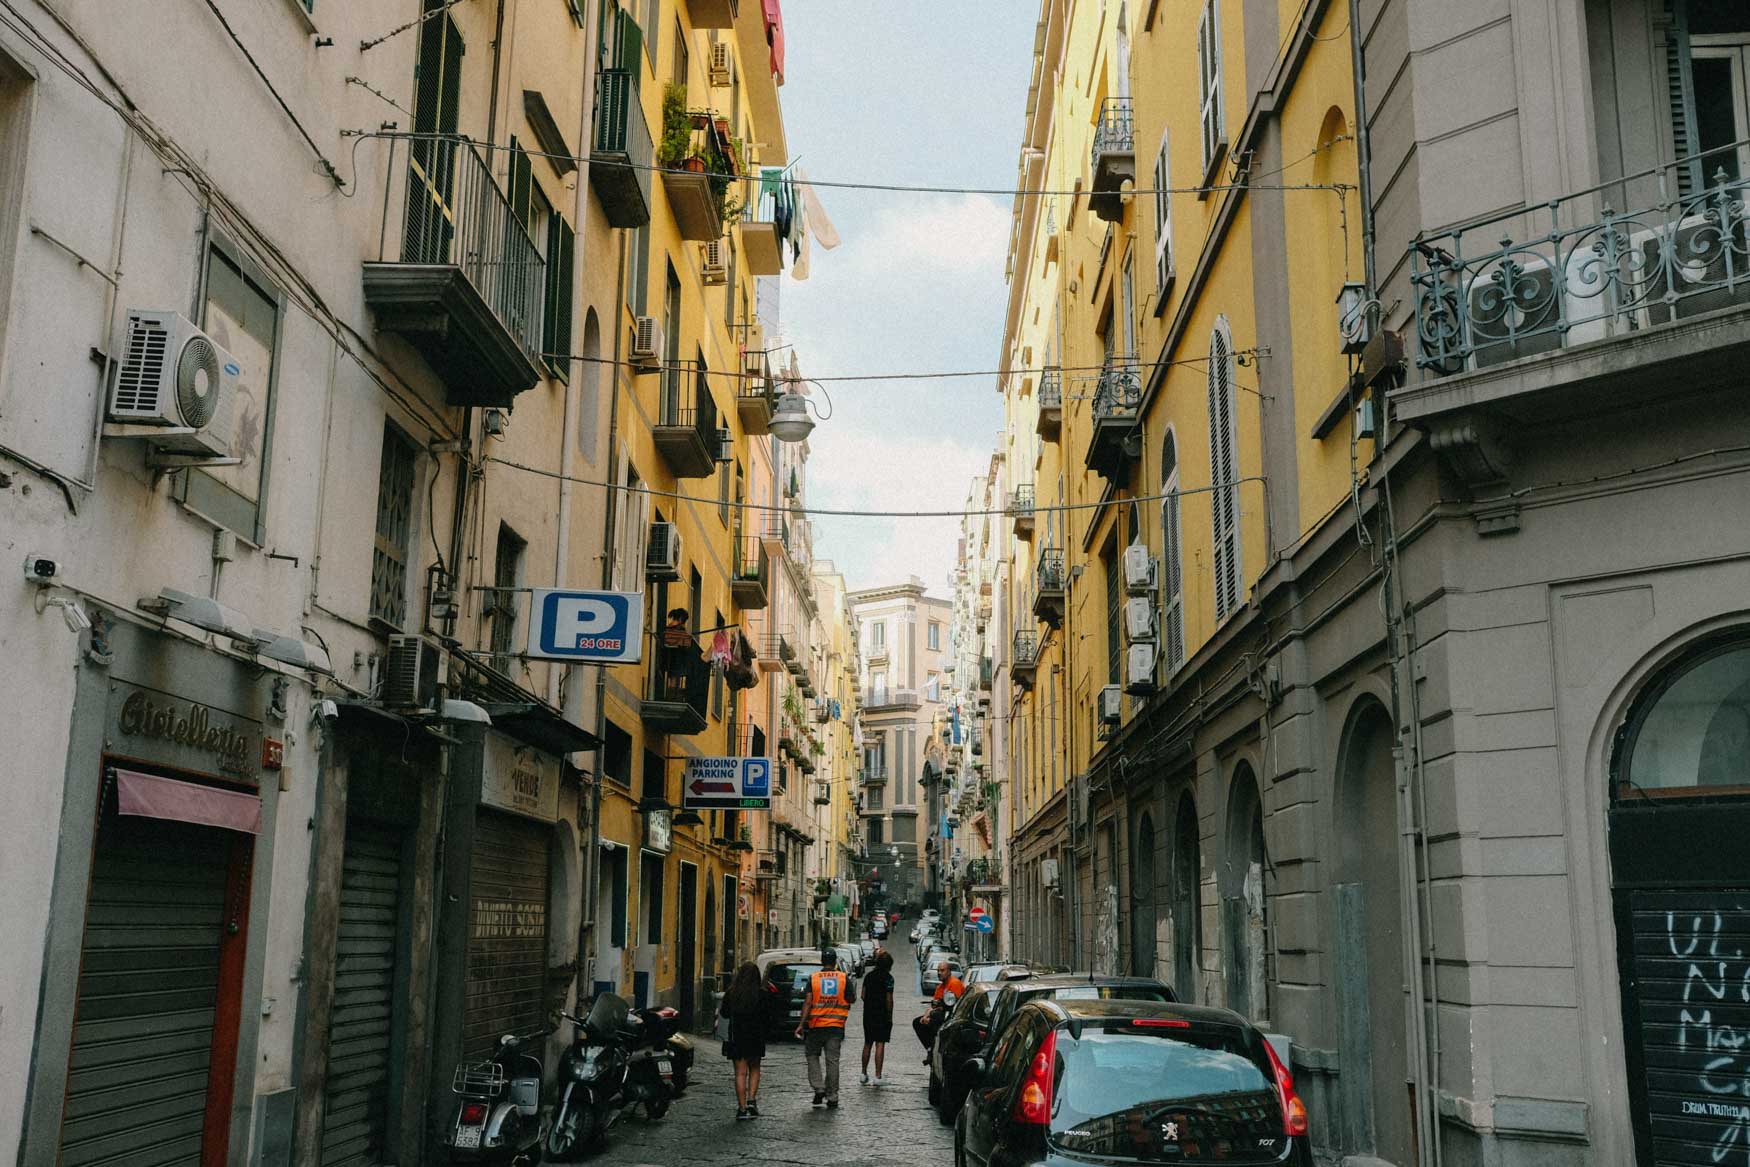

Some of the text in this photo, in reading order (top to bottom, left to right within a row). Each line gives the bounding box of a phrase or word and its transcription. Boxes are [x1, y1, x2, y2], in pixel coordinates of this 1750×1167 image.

[554, 597, 616, 649] P
[580, 638, 621, 650] 24 ORE
[119, 690, 249, 753] Gioielleria
[689, 759, 738, 769] ANGIOINO
[692, 769, 735, 778] PARKING
[747, 763, 764, 785] P
[824, 979, 835, 994] P
[1258, 1138, 1276, 1146] 107
